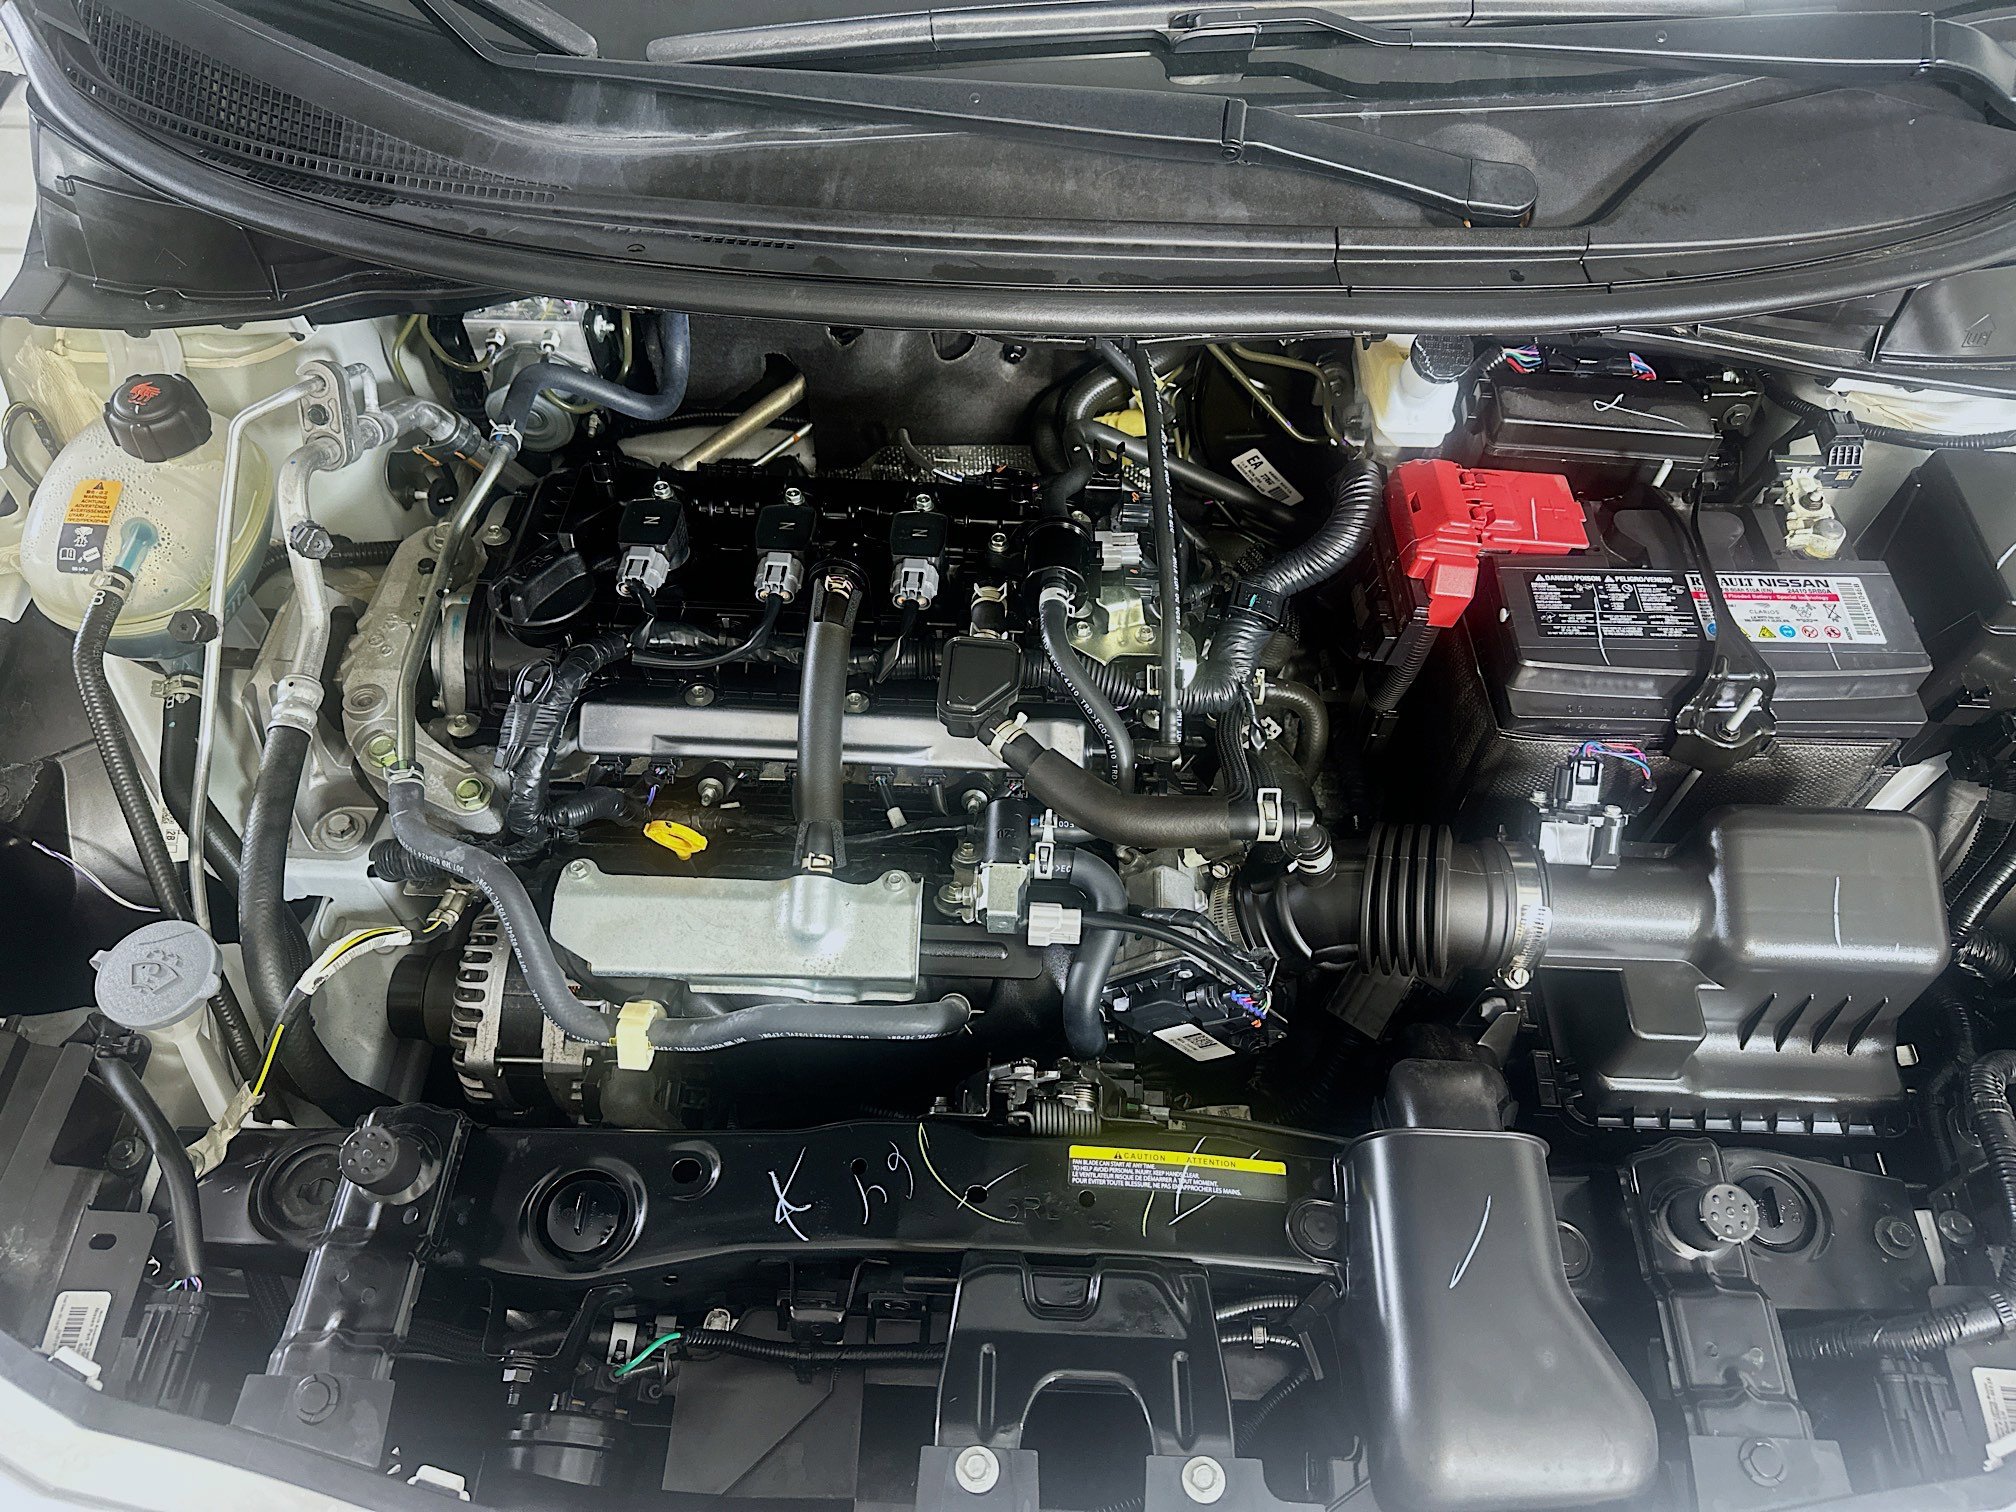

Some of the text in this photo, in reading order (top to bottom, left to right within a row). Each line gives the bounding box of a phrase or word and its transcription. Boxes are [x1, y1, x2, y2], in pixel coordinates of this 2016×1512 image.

[1247, 455, 1264, 470] EA
[1545, 574, 1601, 582] DANGER/POISON
[1690, 576, 1830, 588] RAULT NISSAN
[1124, 1152, 1166, 1162] CAUTION
[1186, 1156, 1236, 1168] ATTENTION
[1182, 1184, 1212, 1192] APPROCHER
